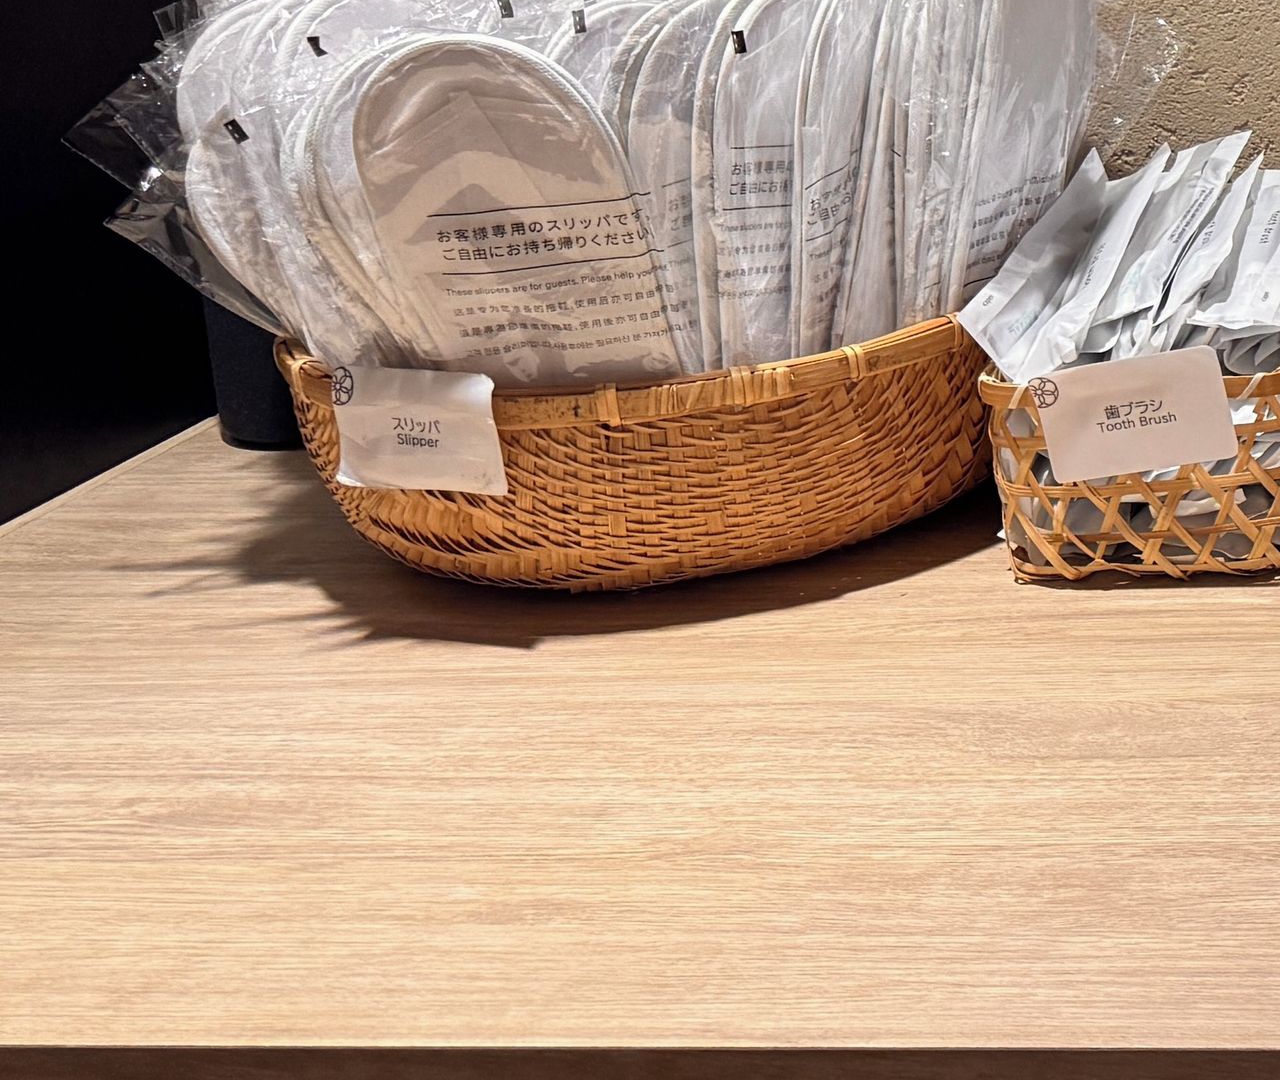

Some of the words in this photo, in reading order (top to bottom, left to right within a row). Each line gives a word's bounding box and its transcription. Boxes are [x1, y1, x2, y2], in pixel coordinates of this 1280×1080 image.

[529, 282, 543, 291] for
[614, 270, 635, 281] help
[1104, 399, 1163, 421] 歯ブラシ
[391, 417, 441, 434] スリッパ
[1096, 417, 1136, 434] Tooth
[1139, 411, 1177, 427] Brush
[397, 433, 440, 448] Slipper
